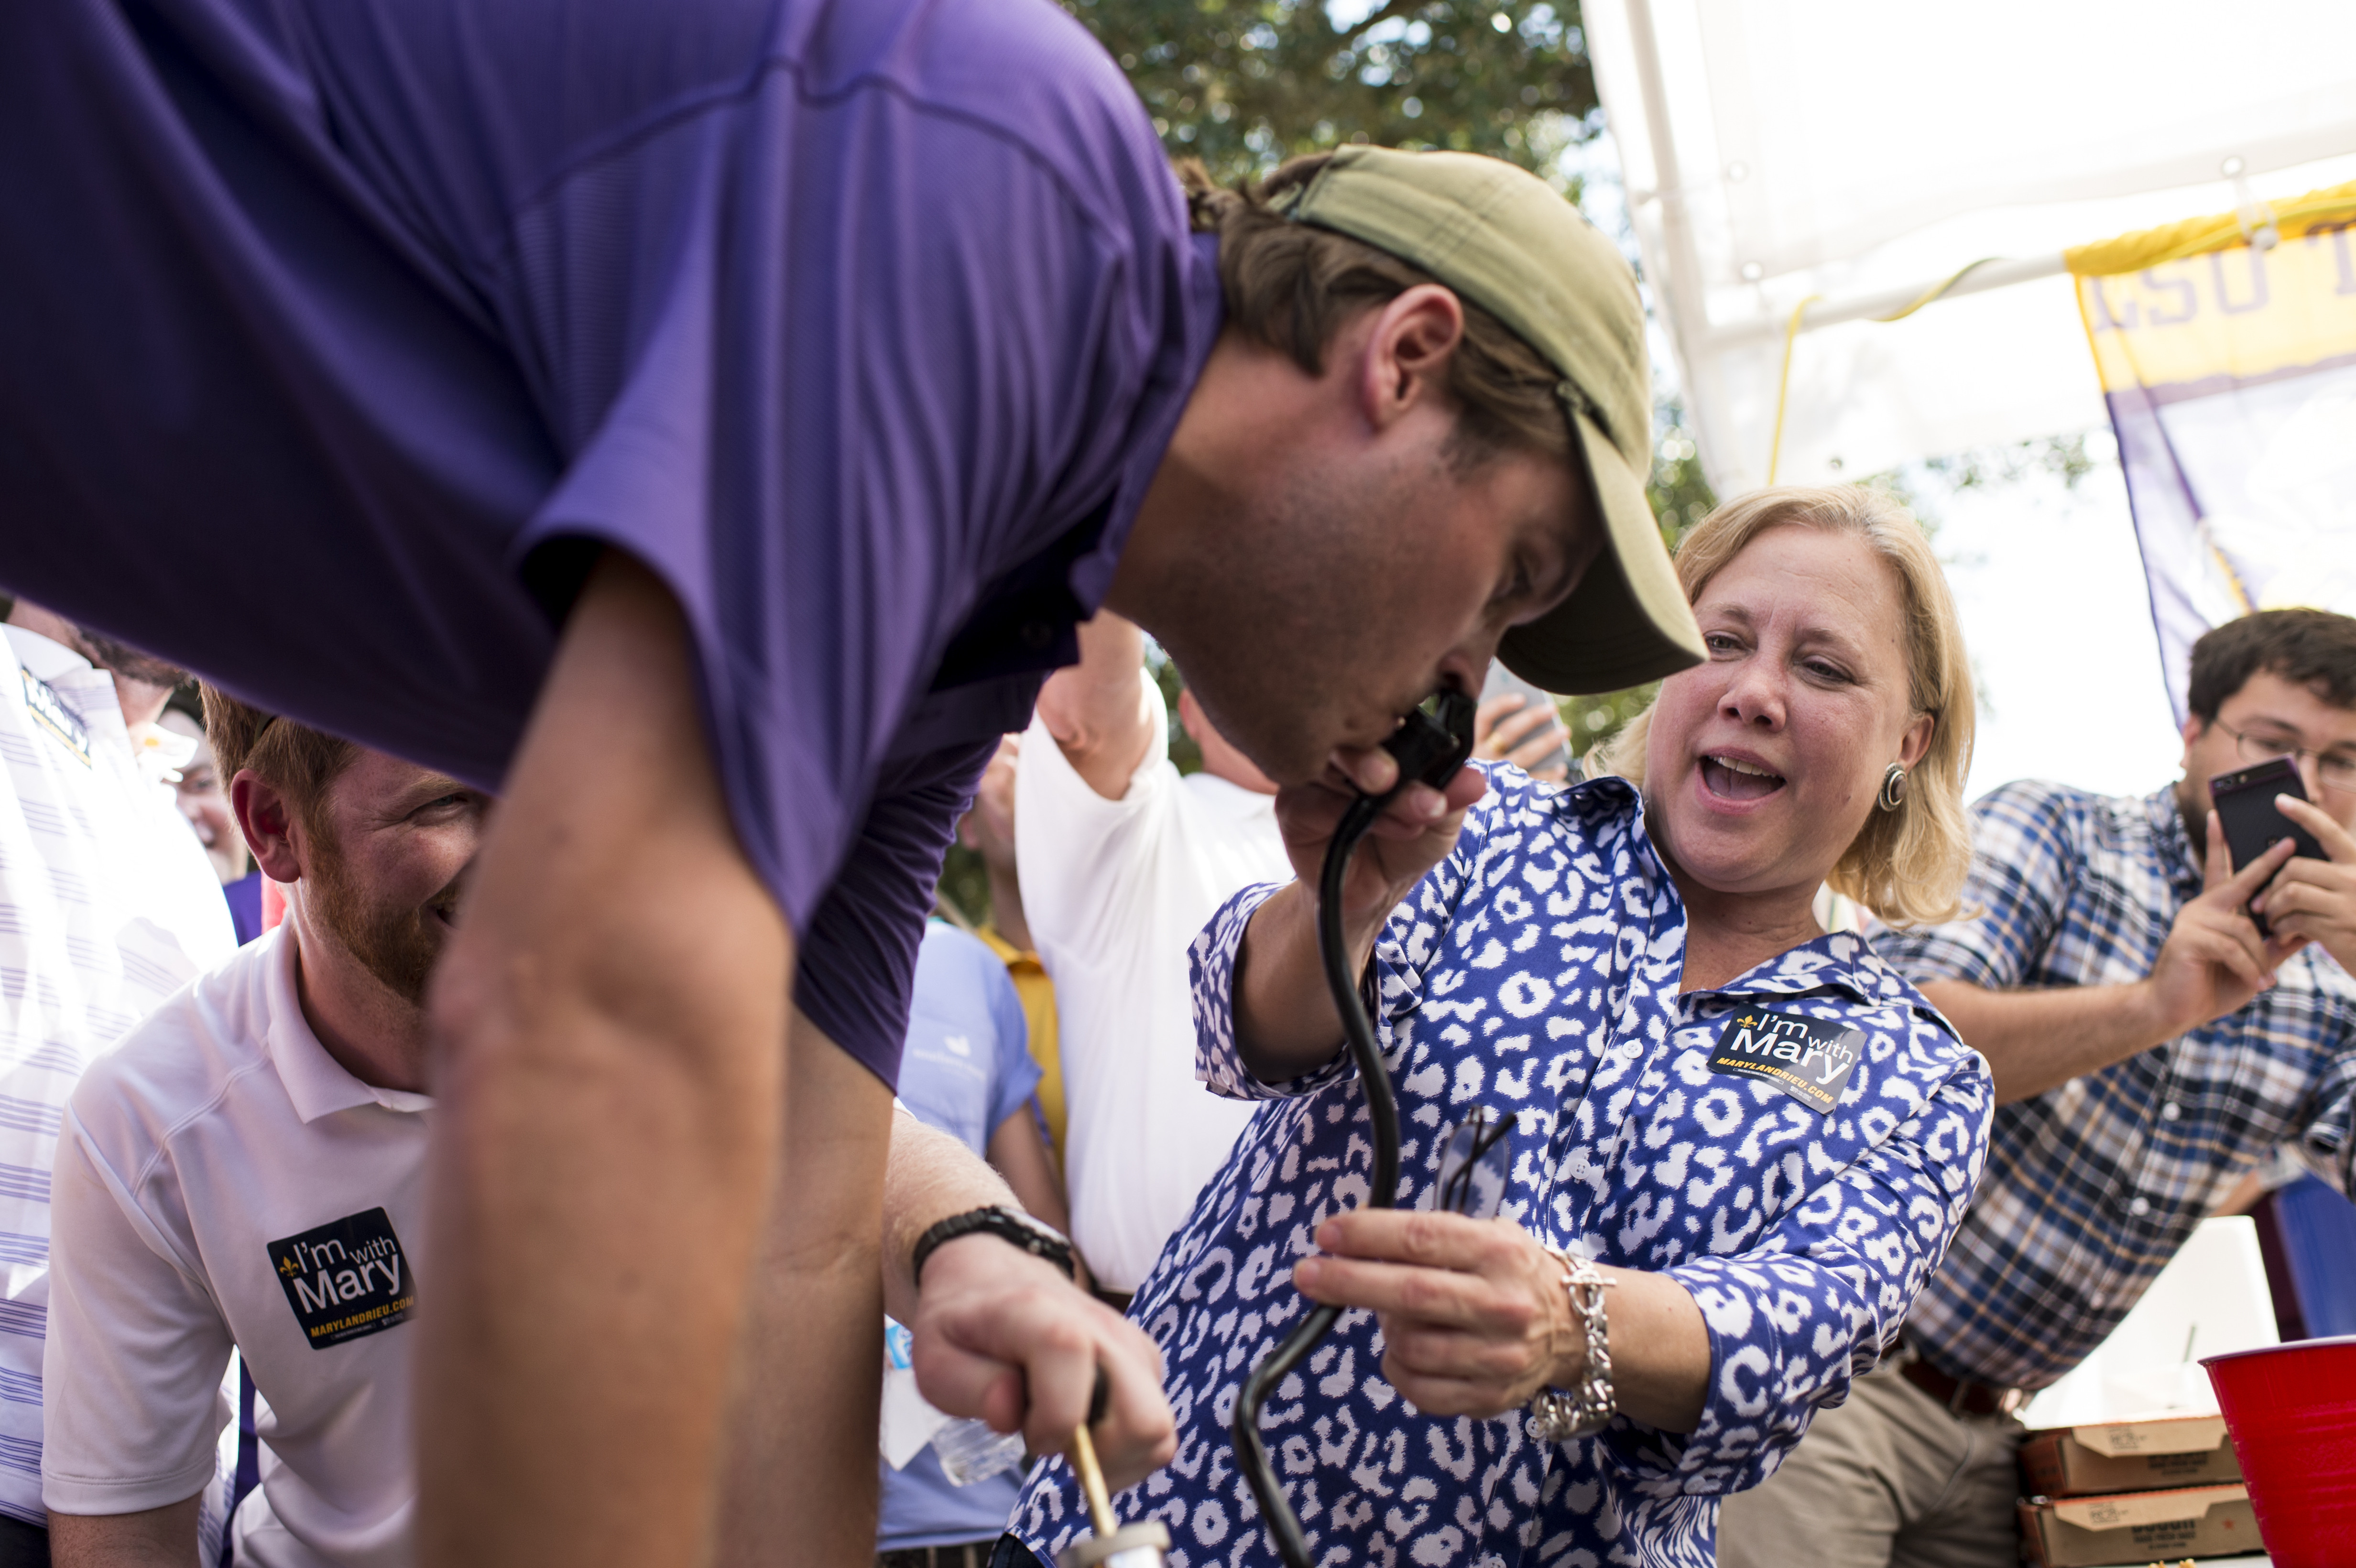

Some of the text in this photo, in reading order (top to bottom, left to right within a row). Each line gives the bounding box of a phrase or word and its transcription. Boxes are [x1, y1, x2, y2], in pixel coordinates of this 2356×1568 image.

[1730, 1028, 1849, 1085] Mary
[1757, 1013, 1853, 1064] I'm with
[1716, 1057, 1834, 1103] MARYLANDRIEU.COM
[293, 1236, 396, 1274] I'm with
[293, 1253, 400, 1314] Mary
[310, 1295, 414, 1337] MARYLANDRIEU.COM
